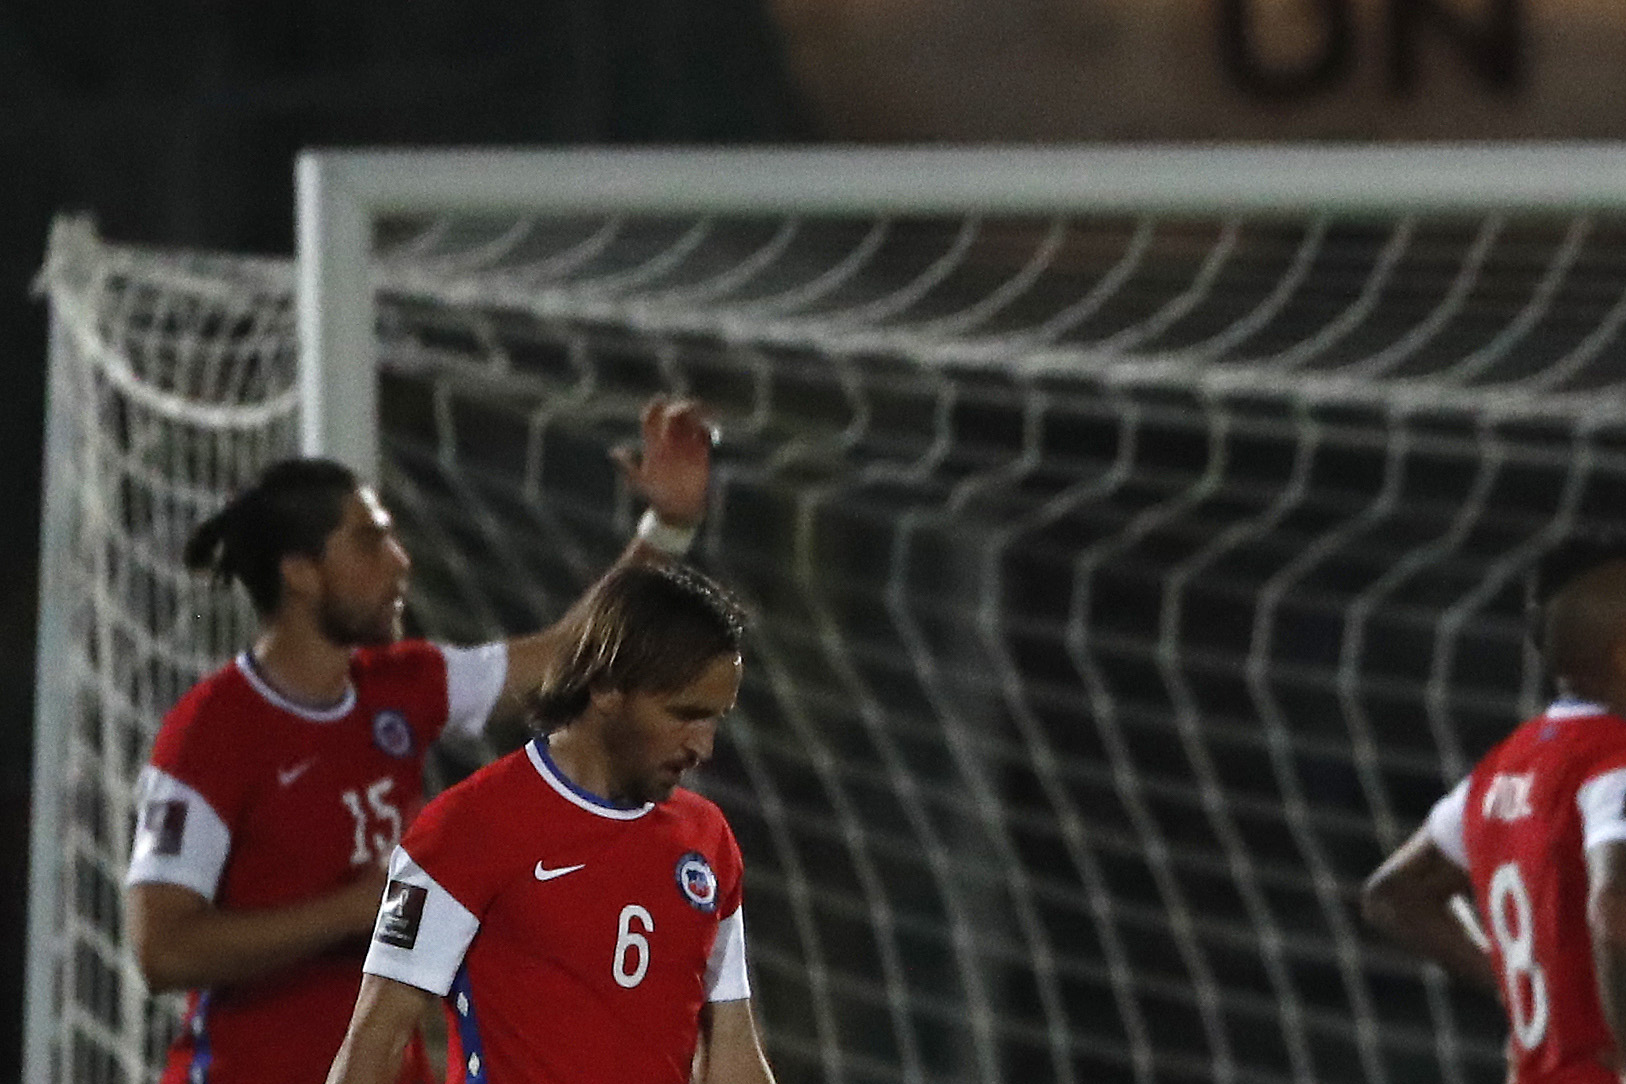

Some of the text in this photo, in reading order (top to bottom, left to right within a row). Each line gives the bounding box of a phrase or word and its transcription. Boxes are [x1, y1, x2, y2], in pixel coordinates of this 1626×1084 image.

[1214, 0, 1524, 106] UN
[342, 777, 401, 864] 15
[612, 904, 654, 988] 6
[1490, 862, 1547, 1048] 8
